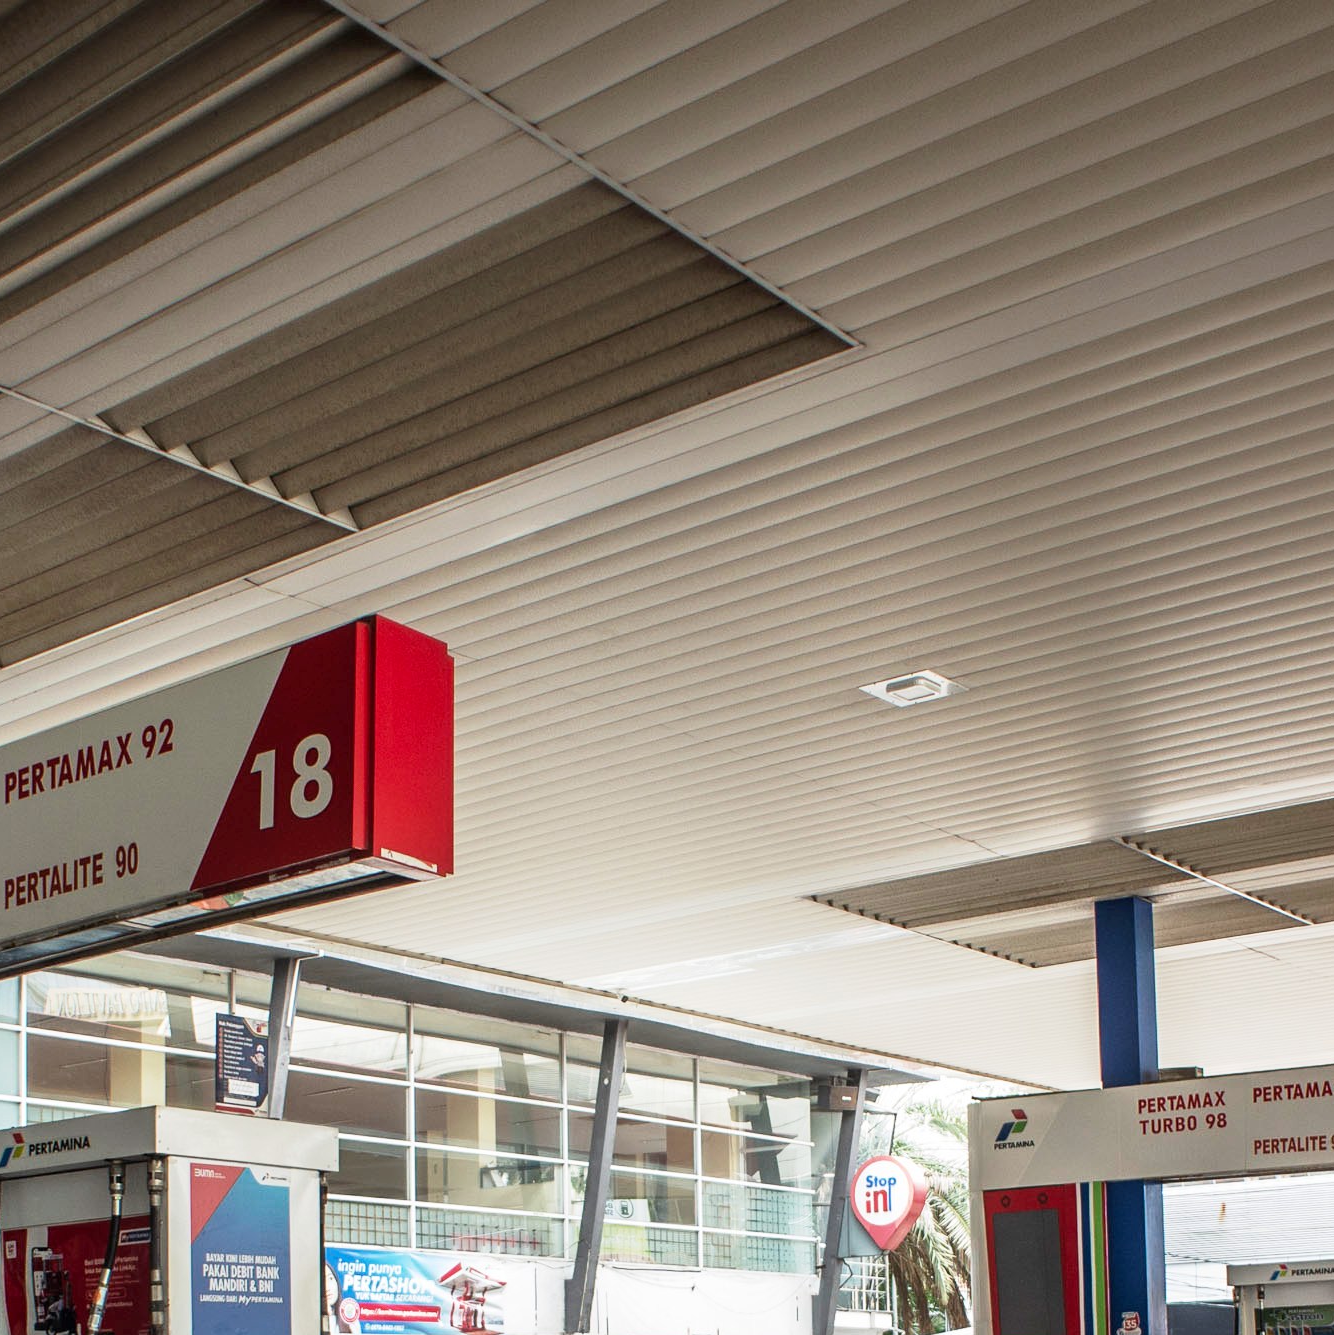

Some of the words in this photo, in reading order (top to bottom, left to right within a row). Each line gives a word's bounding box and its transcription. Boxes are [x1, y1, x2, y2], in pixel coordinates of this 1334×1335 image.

[4, 733, 132, 804] PERTAMAX
[141, 718, 174, 761] 92
[250, 733, 334, 829] 18
[4, 853, 104, 909] PERTALITE
[116, 841, 139, 878] 90
[1137, 1091, 1226, 1115] PERTAMAX
[1139, 1115, 1198, 1134] TURBO
[1205, 1112, 1227, 1130] 98
[28, 1134, 91, 1157] PERTAMINA
[994, 1139, 1035, 1151] PERTAMINA
[1253, 1136, 1326, 1156] PERTALITE
[206, 1253, 224, 1263] BAYAR
[238, 1255, 254, 1264] LEBIH
[254, 1255, 277, 1265] MUDAH
[338, 1258, 366, 1275] ingin
[368, 1262, 402, 1278] punya
[203, 1264, 229, 1278] PAKAI
[230, 1265, 255, 1279] DEBIT
[256, 1266, 280, 1280] BANK
[209, 1278, 248, 1292] MANDIRI
[249, 1279, 257, 1292] &
[259, 1280, 274, 1293] BNI
